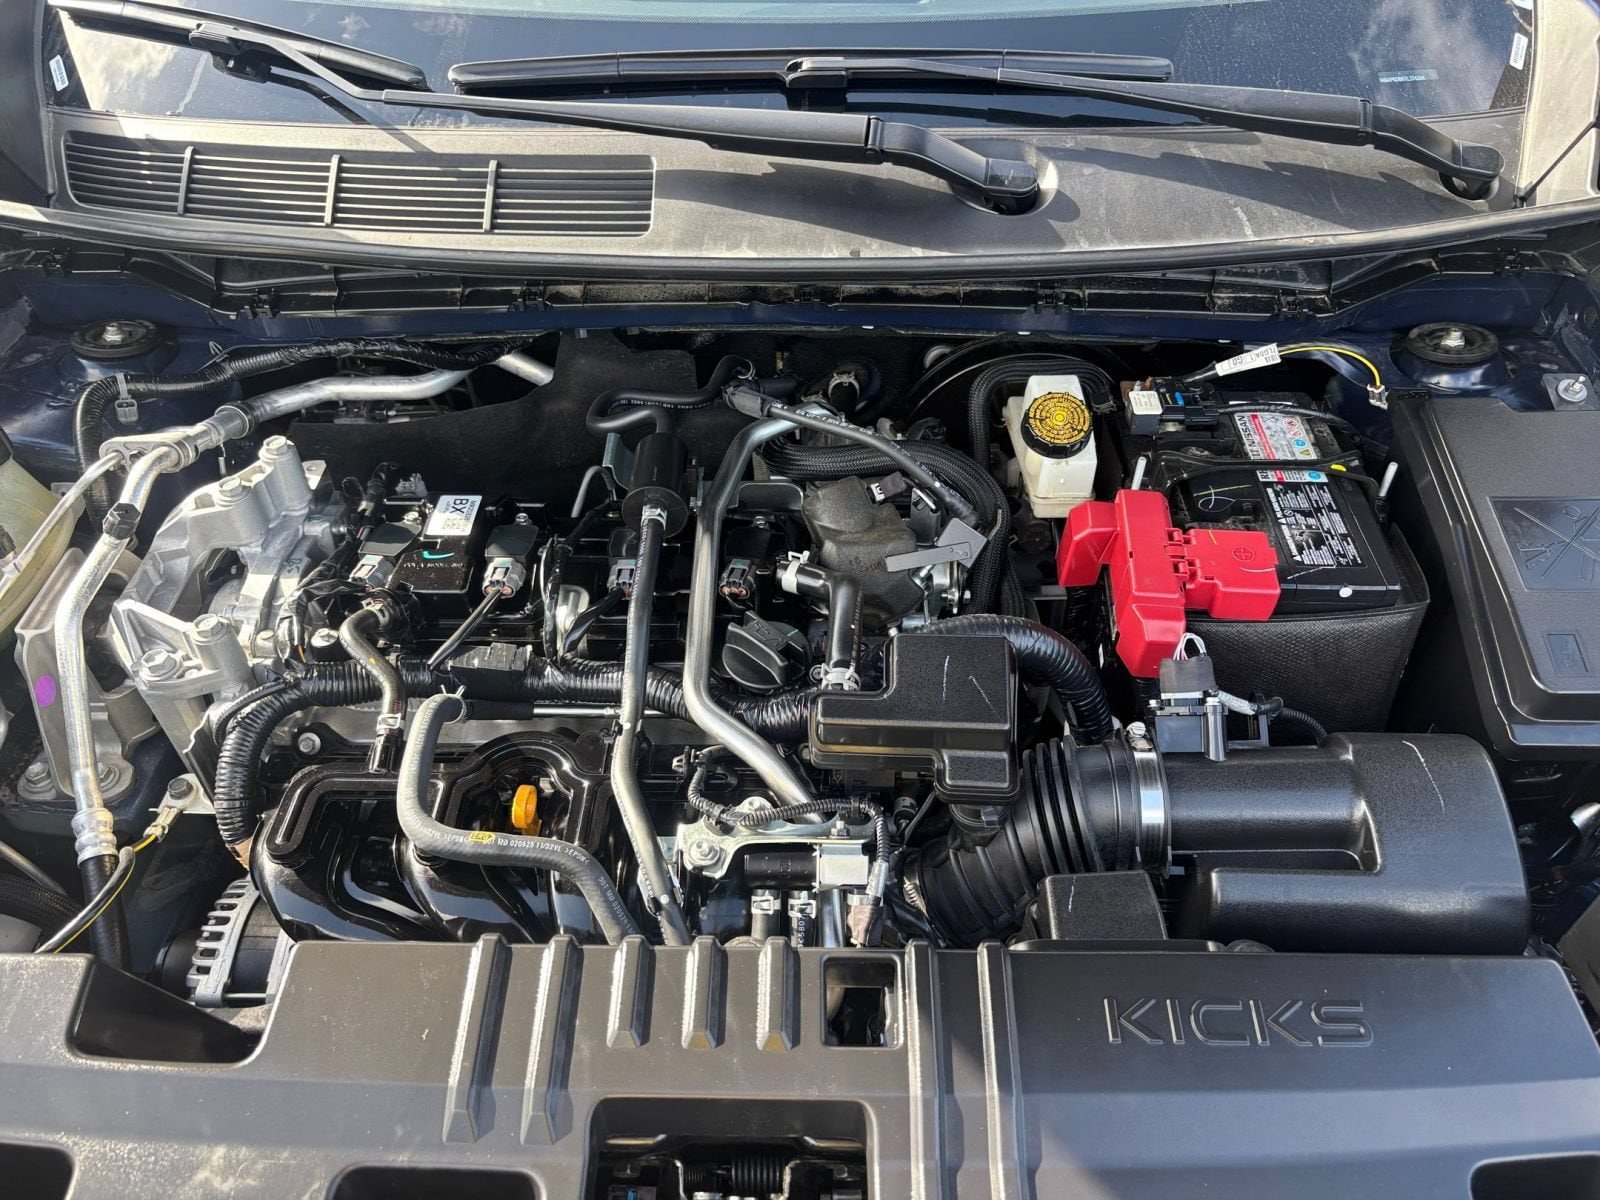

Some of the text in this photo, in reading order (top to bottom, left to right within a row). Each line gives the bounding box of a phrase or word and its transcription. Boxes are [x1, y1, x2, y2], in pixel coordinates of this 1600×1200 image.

[1236, 415, 1257, 447] NISSAN
[450, 498, 469, 514] BX
[1104, 998, 1374, 1046] KICKS
